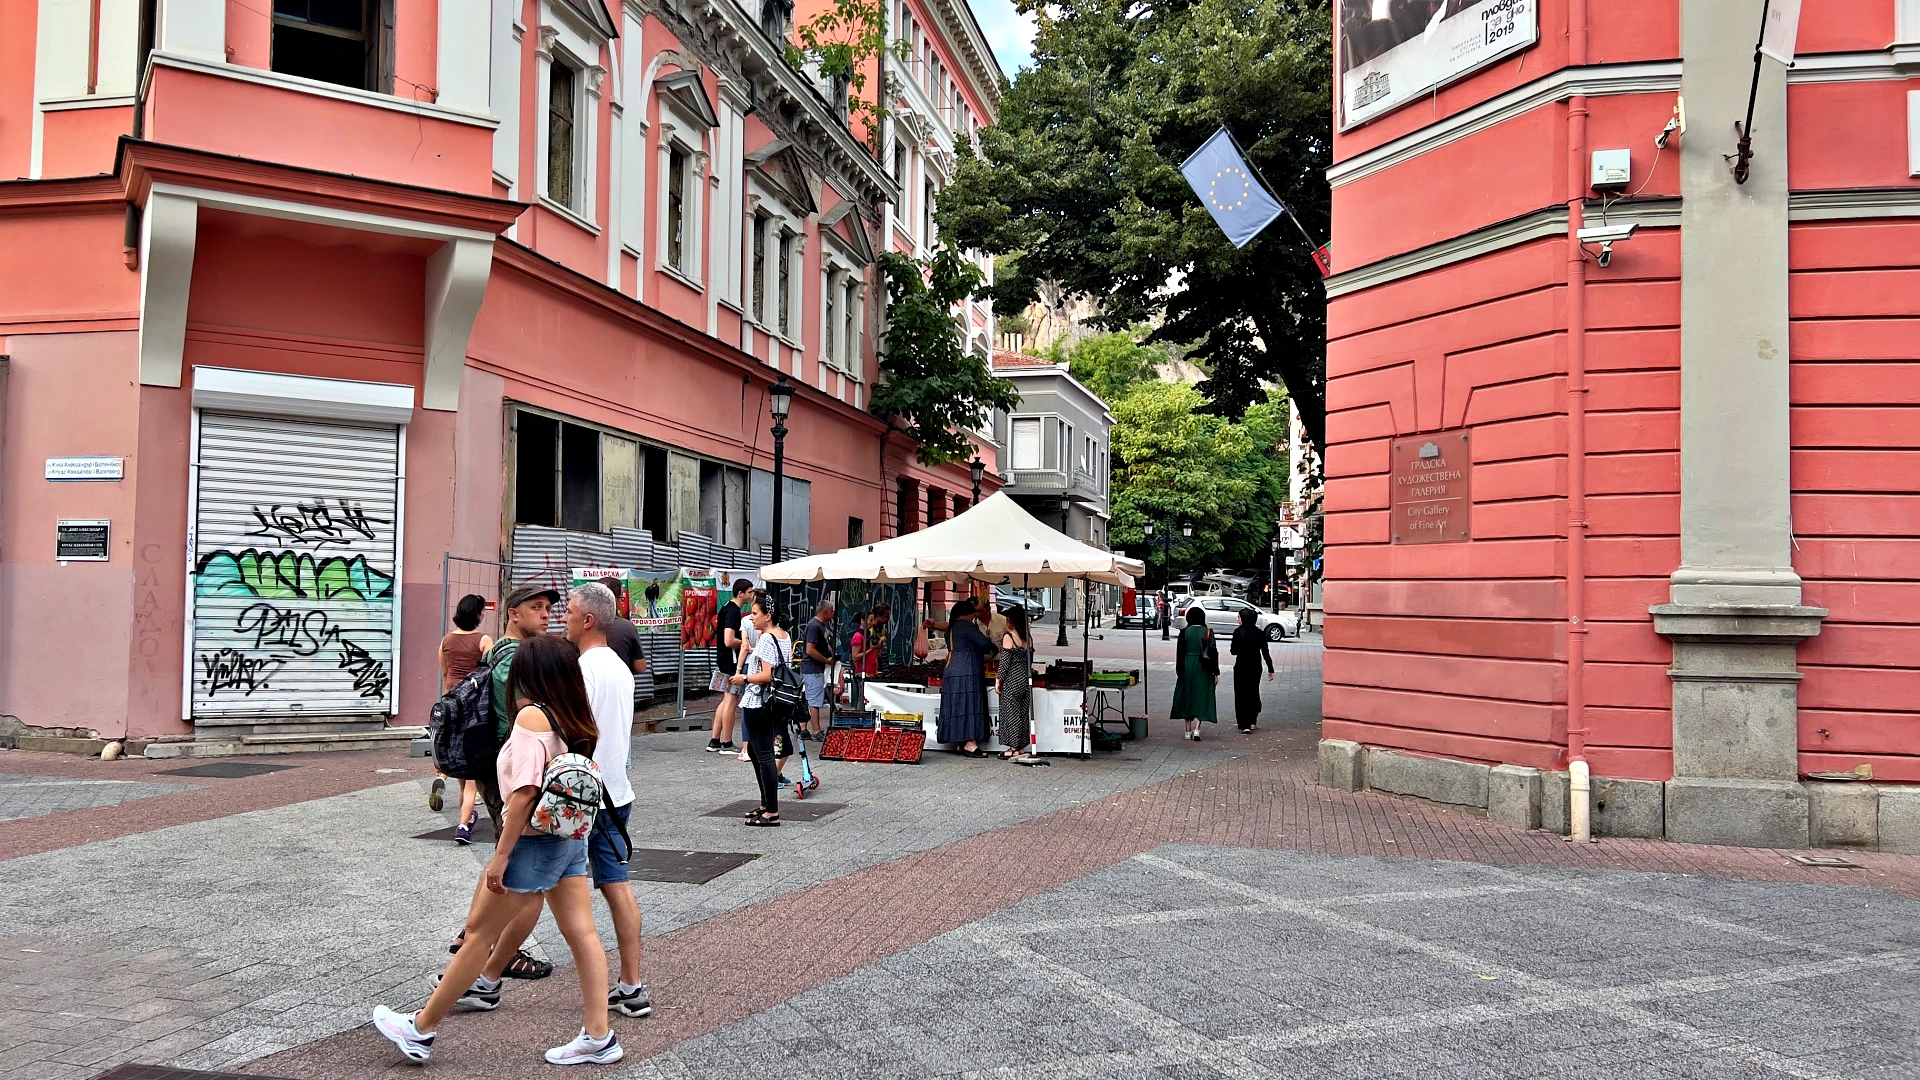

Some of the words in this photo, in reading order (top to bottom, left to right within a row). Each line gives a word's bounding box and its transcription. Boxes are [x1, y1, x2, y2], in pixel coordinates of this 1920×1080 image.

[1488, 21, 1515, 44] 2019
[1411, 458, 1446, 470] ГРАДСКА
[1397, 470, 1462, 485] ХУДОЖЕСТВЕНА
[1411, 485, 1446, 497] ГАЛЕРИЯ
[1407, 507, 1422, 518] City
[1423, 504, 1450, 517] Gallery
[1410, 520, 1418, 530] of
[1418, 520, 1434, 530] Fine
[1436, 519, 1447, 529] Art
